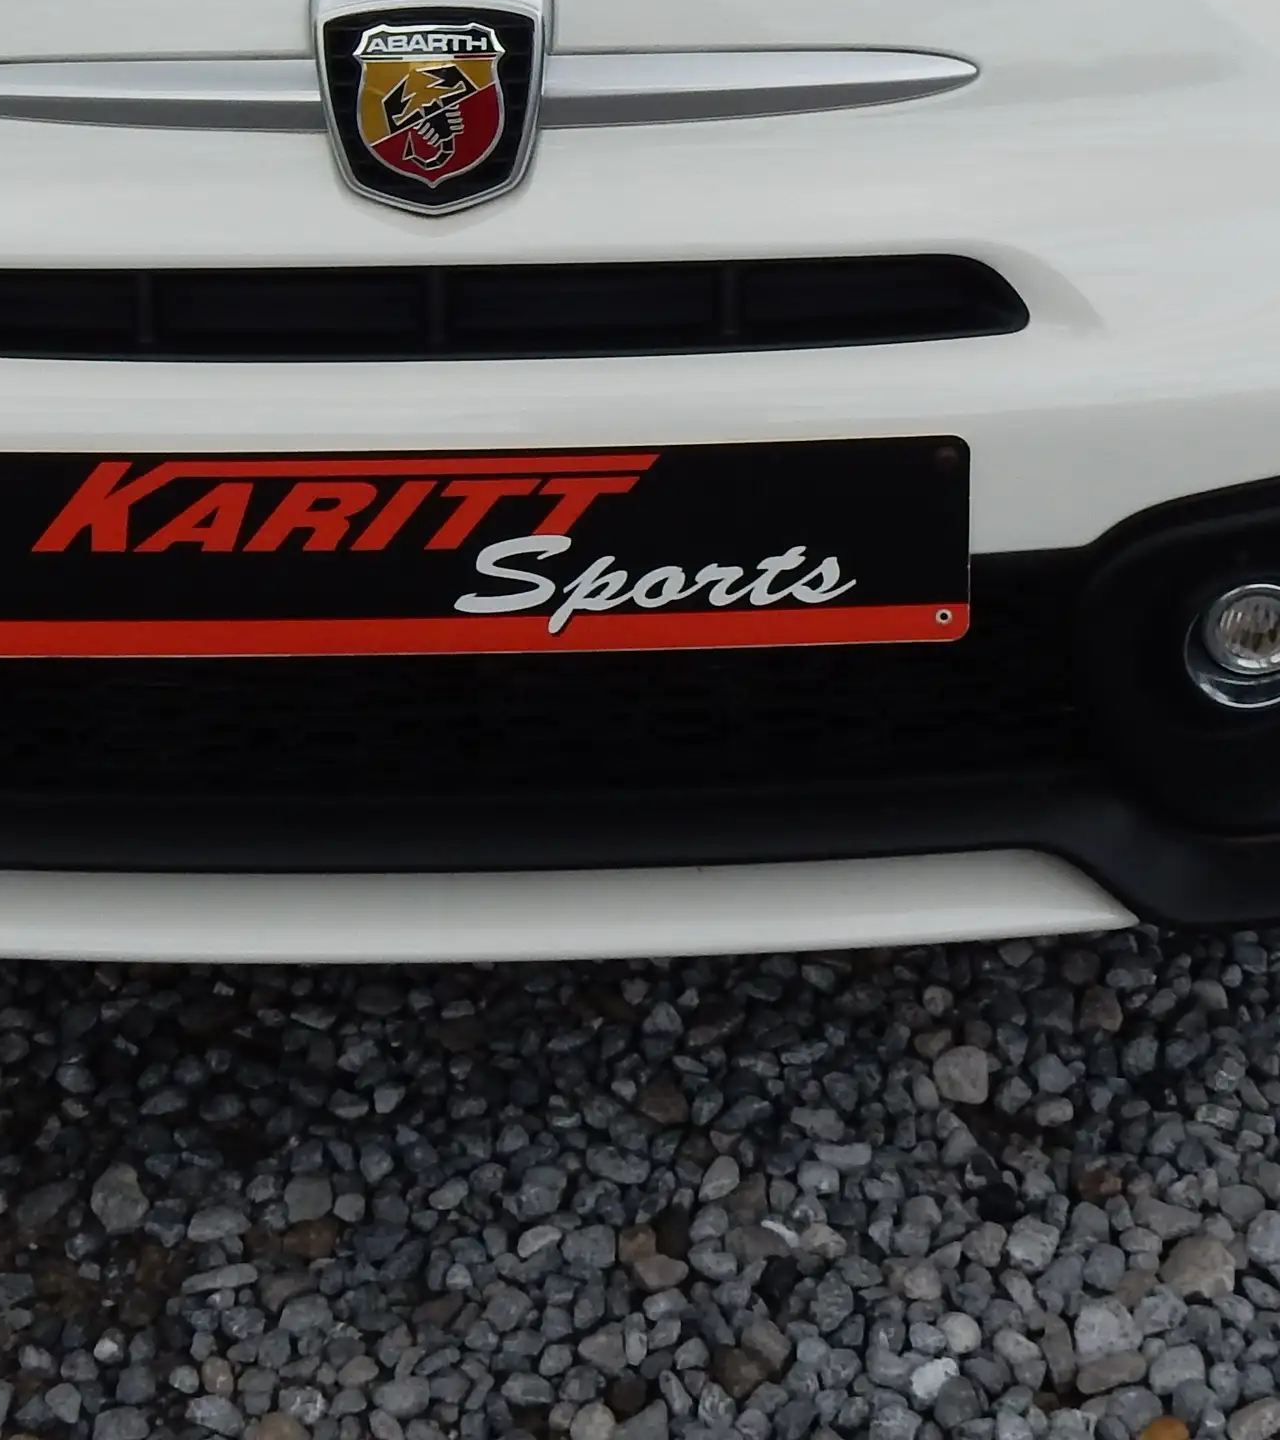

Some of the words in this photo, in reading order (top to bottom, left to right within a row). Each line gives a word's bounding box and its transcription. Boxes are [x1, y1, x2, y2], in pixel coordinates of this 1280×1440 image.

[366, 33, 488, 52] ABARTH
[31, 453, 661, 553] KARITT
[453, 534, 857, 635] Sports
